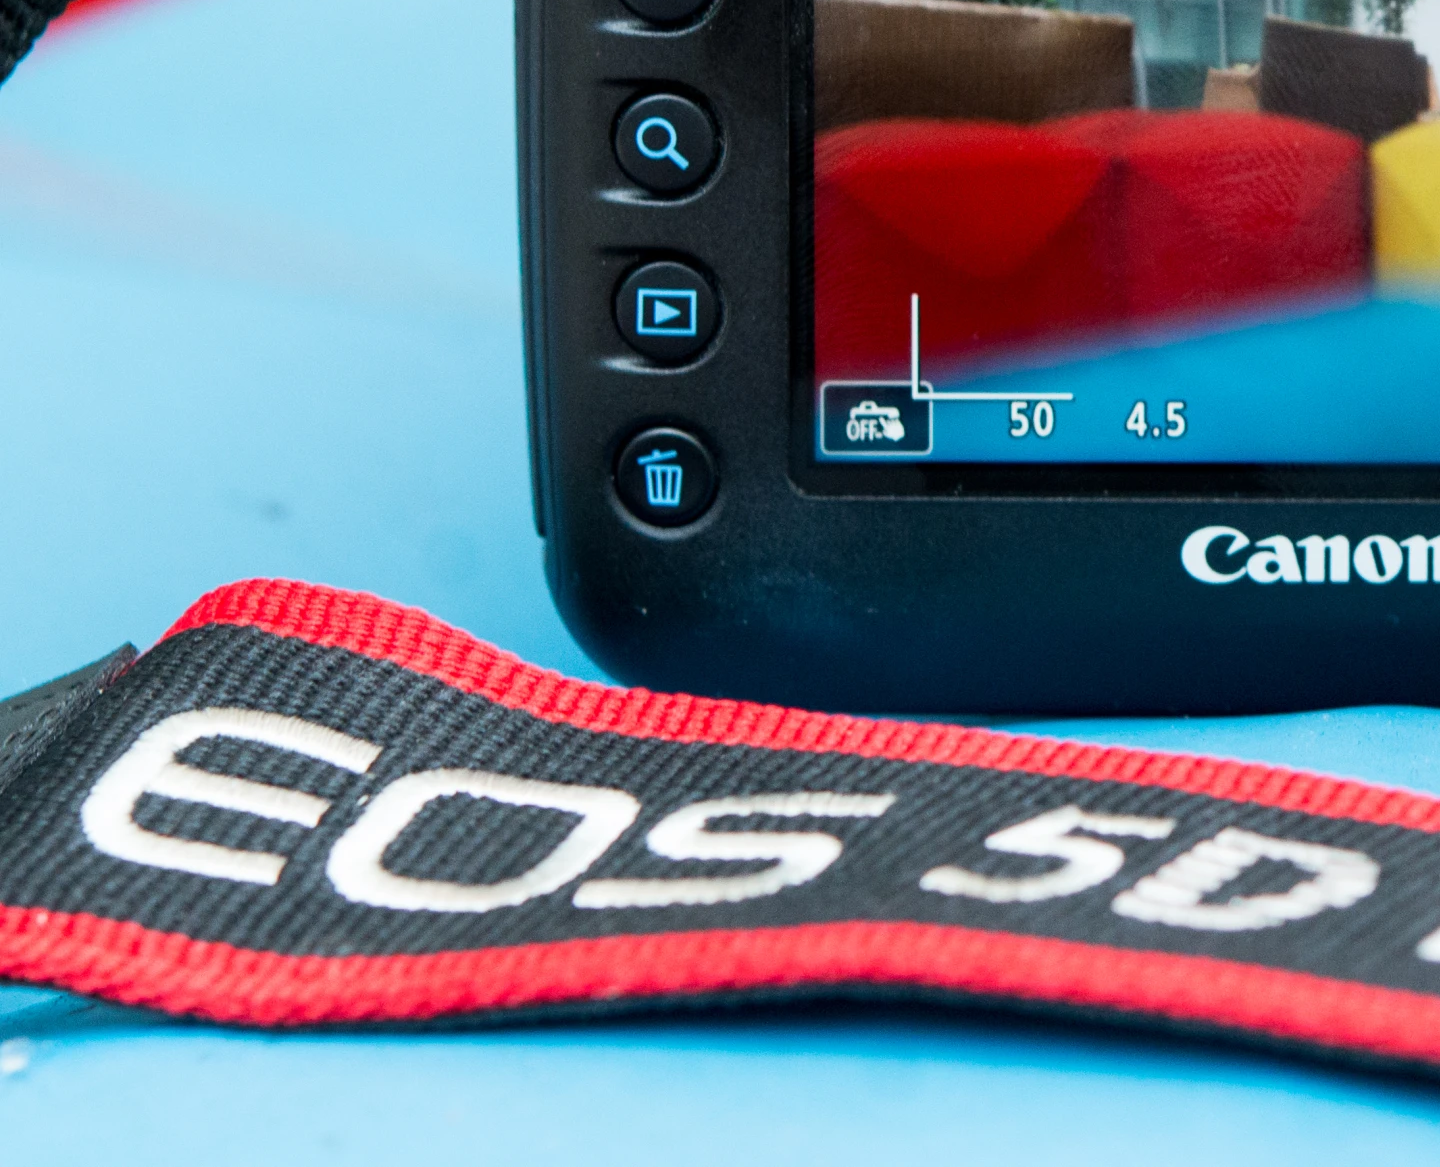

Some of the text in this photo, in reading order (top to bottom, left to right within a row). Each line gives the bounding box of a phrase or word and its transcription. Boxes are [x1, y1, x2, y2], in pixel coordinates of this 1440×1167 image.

[1010, 401, 1055, 438] 50
[1126, 400, 1188, 438] 4.5
[80, 706, 896, 913] EOS
[919, 804, 1380, 932] 5D
